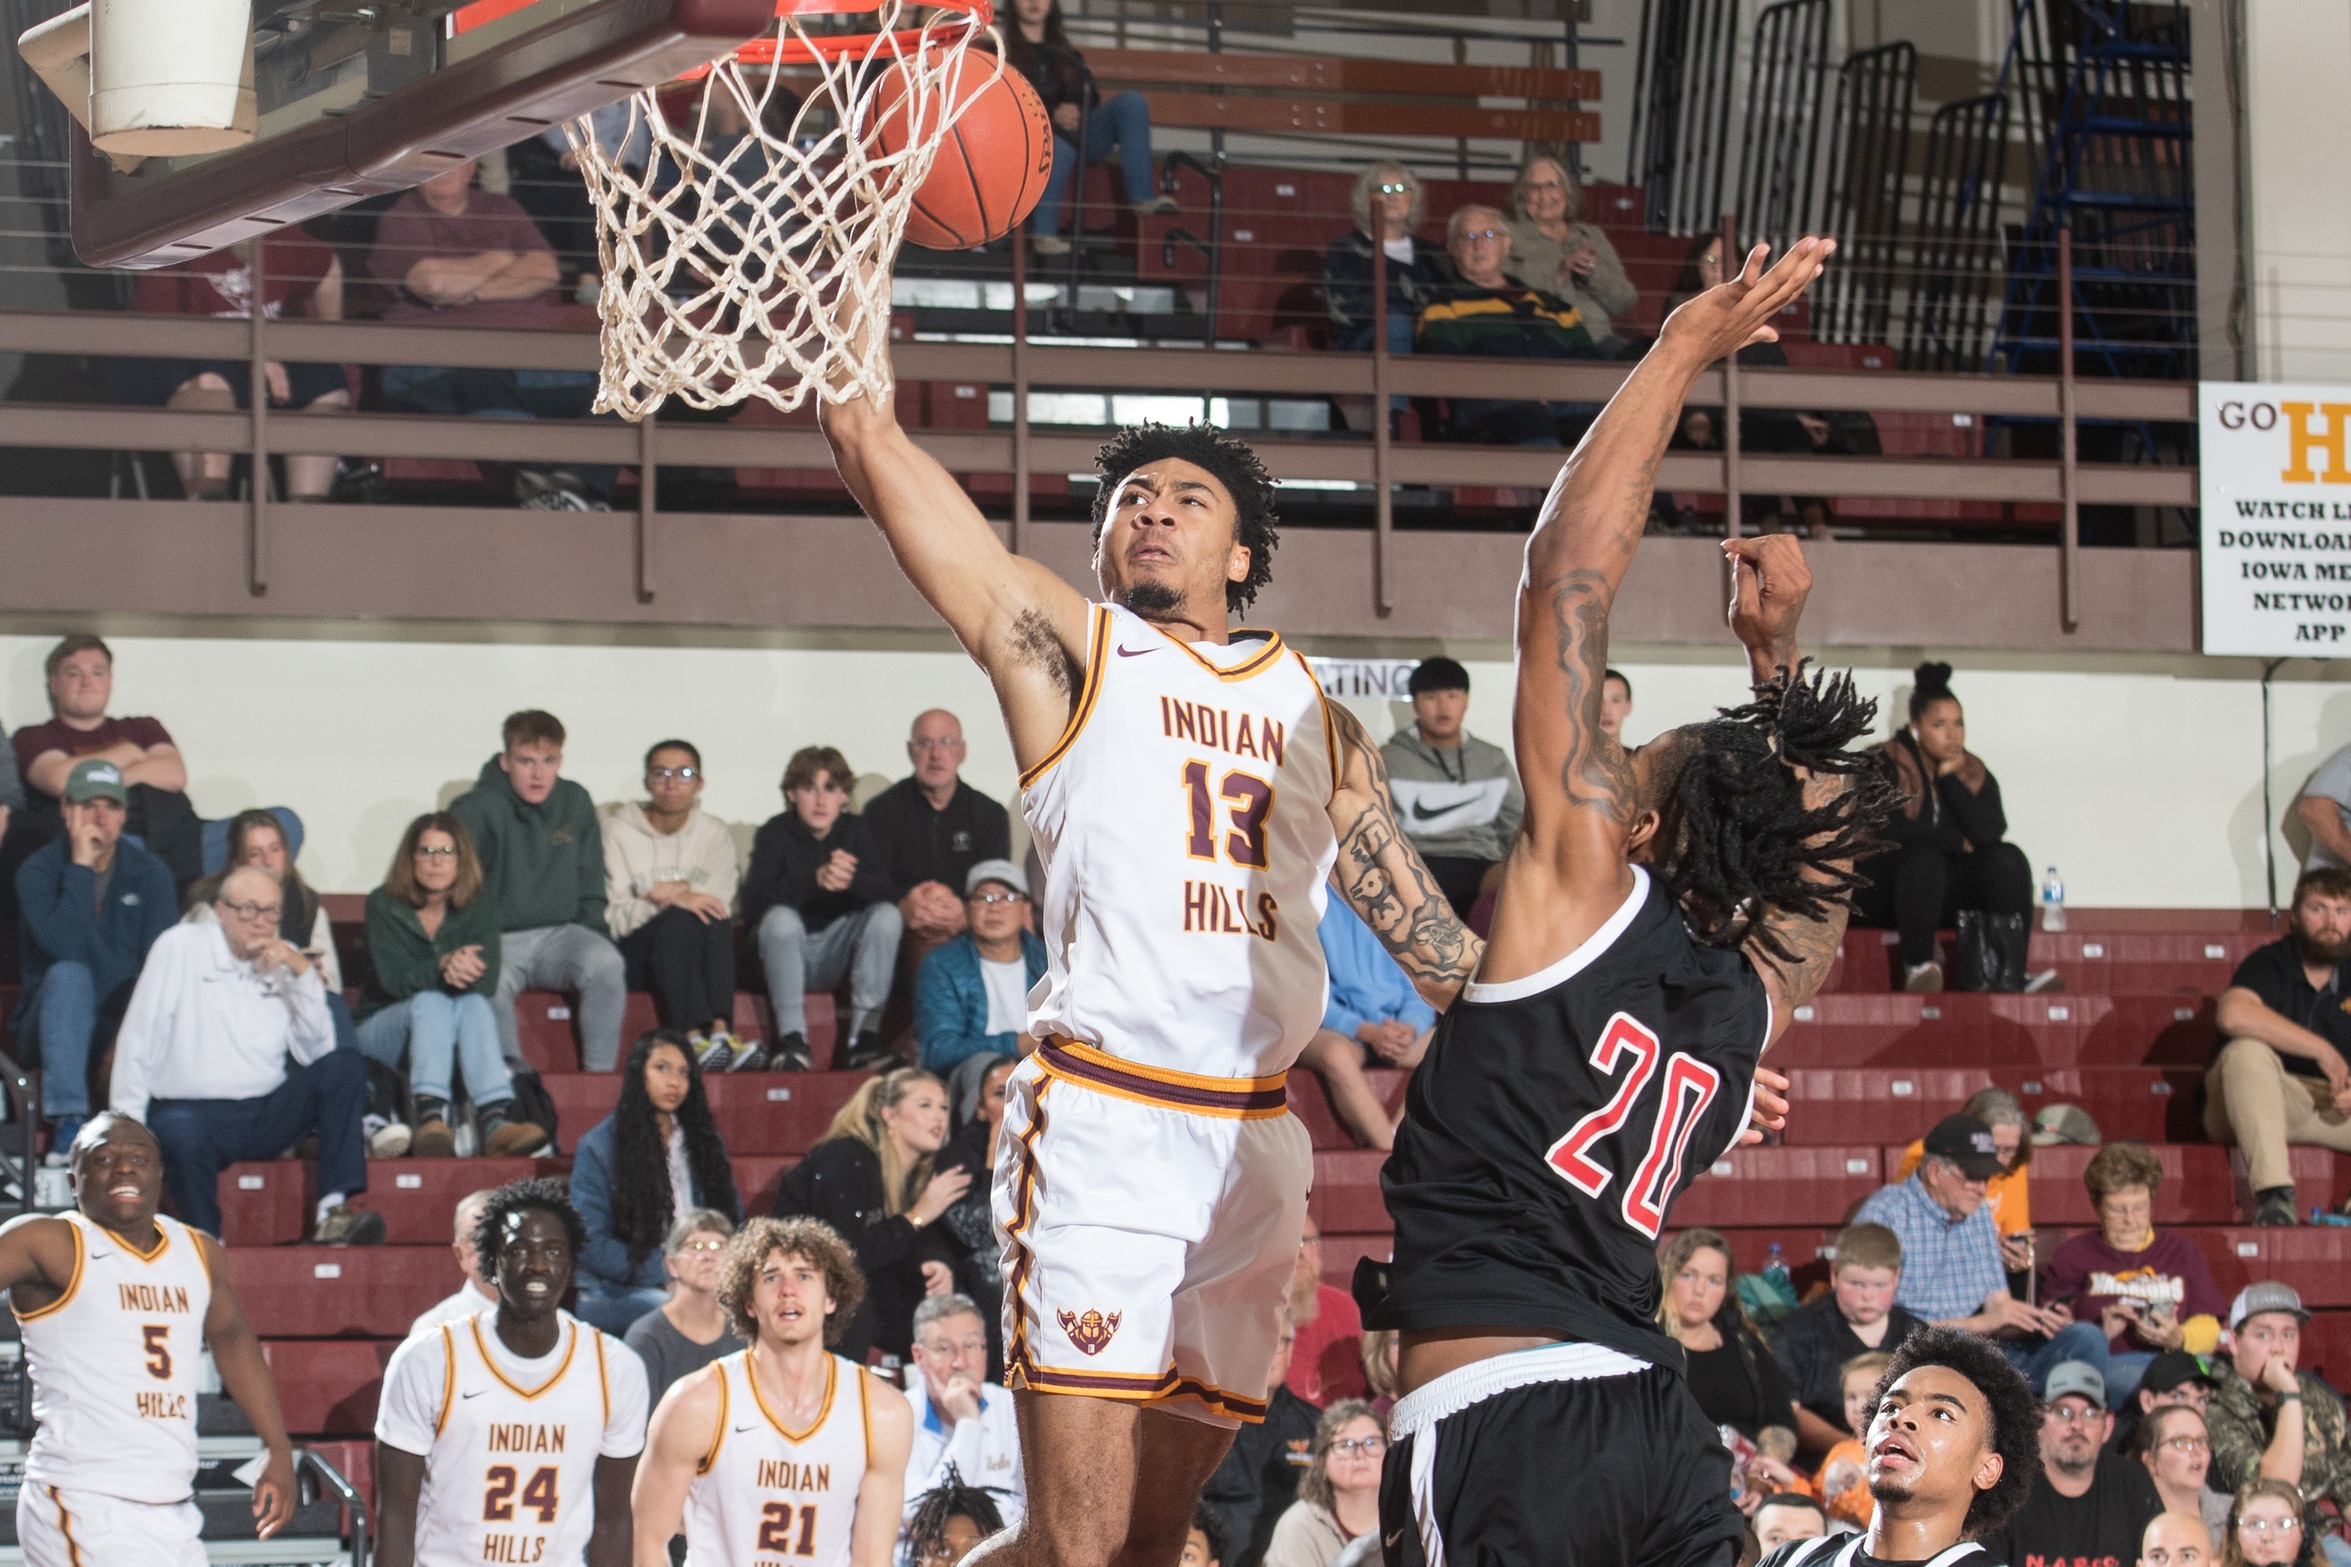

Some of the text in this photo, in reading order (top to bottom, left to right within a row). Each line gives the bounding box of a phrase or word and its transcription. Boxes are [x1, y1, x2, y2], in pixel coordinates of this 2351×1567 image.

[2218, 402, 2277, 431] GO
[2235, 501, 2351, 520] WATCH L
[2219, 531, 2351, 551] DOWNLOA
[2241, 562, 2307, 580] IOWA
[2254, 592, 2351, 611] NETWO
[2295, 624, 2346, 642] APP
[1160, 695, 1285, 768] INDIAN
[1181, 757, 1276, 872] 13
[1183, 879, 1278, 942] HILLS
[1544, 1011, 1720, 1241] 20
[118, 1283, 190, 1314] INDIAN
[141, 1323, 172, 1380] 5
[488, 1423, 566, 1453] INDIAN
[757, 1458, 830, 1492] INDIAN
[482, 1463, 559, 1524] 24
[756, 1500, 817, 1557] 21
[483, 1533, 545, 1564] HILLS
